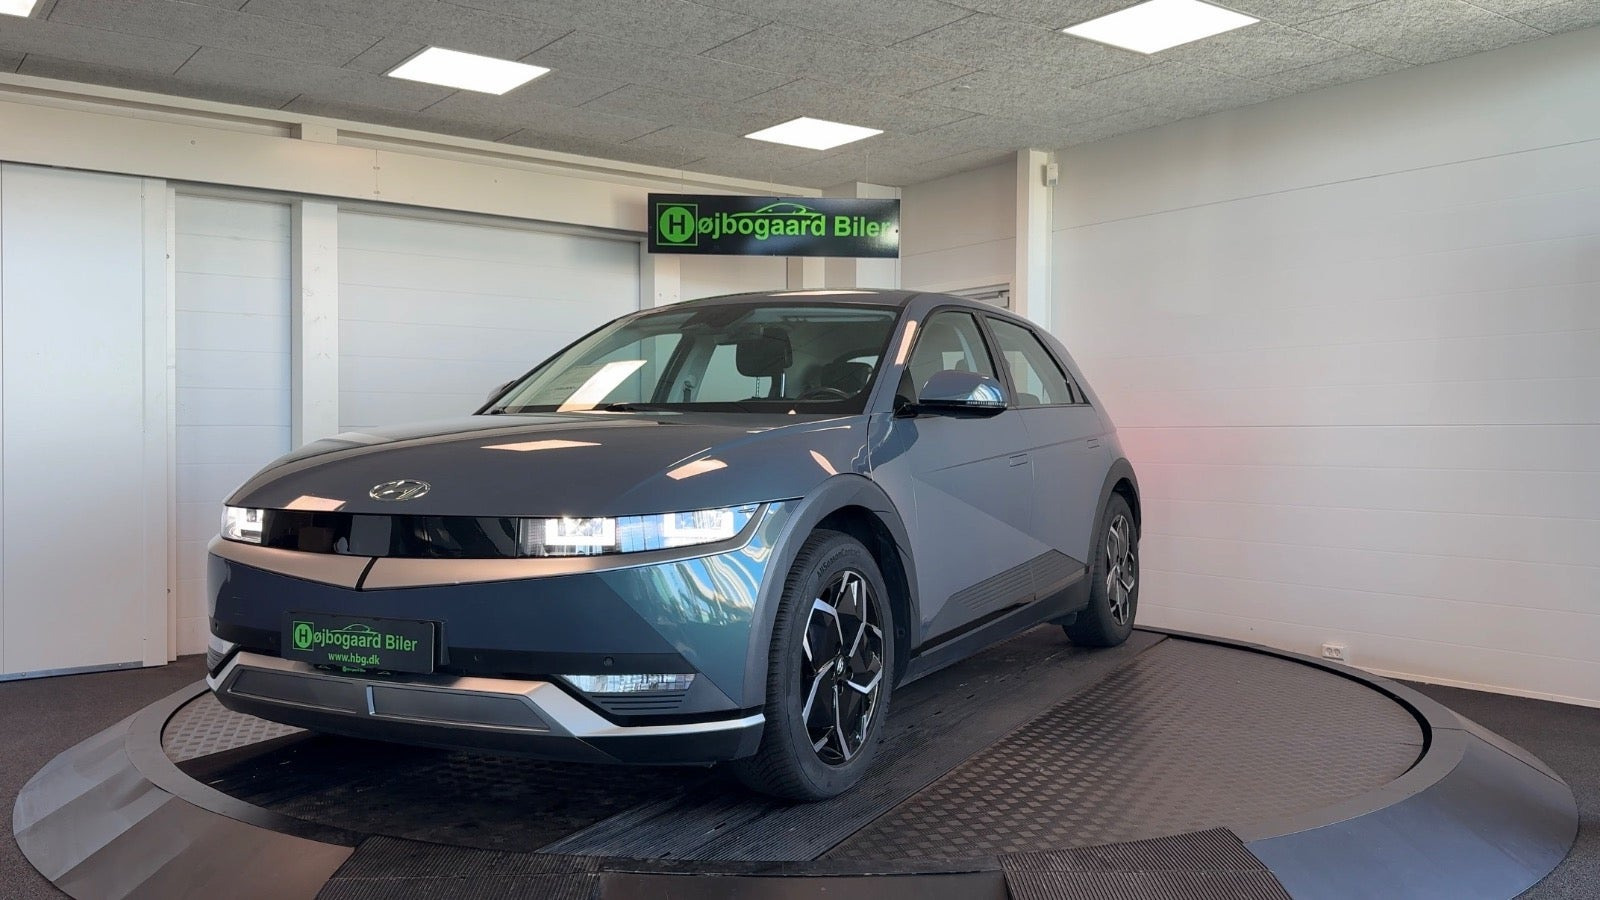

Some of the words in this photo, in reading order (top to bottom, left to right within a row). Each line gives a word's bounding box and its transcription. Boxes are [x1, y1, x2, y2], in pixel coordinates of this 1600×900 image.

[667, 212, 826, 241] Højbogaard
[834, 215, 892, 238] Biler
[299, 628, 382, 650] Højbogaard
[385, 634, 418, 652] Biler
[328, 652, 380, 667] www.hbg.dk
